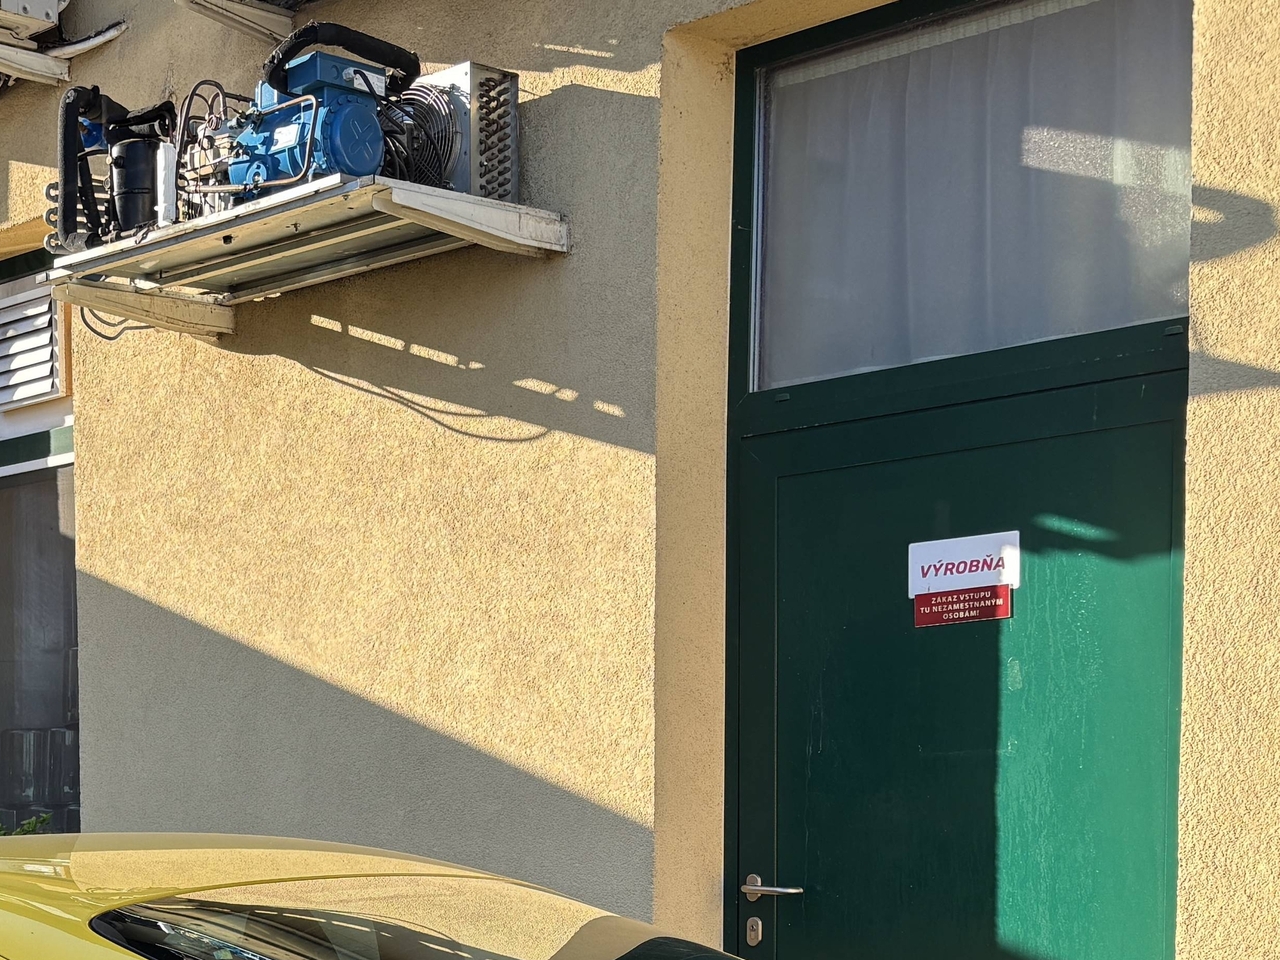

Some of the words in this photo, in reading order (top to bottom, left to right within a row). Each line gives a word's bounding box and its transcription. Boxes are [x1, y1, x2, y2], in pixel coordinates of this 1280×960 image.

[920, 554, 1005, 578] VÝROBŇA
[931, 594, 958, 604] ZÁKAZ
[959, 591, 991, 601] VSTUPU
[920, 606, 930, 614] TU
[942, 609, 980, 620] OSOBÁM!
